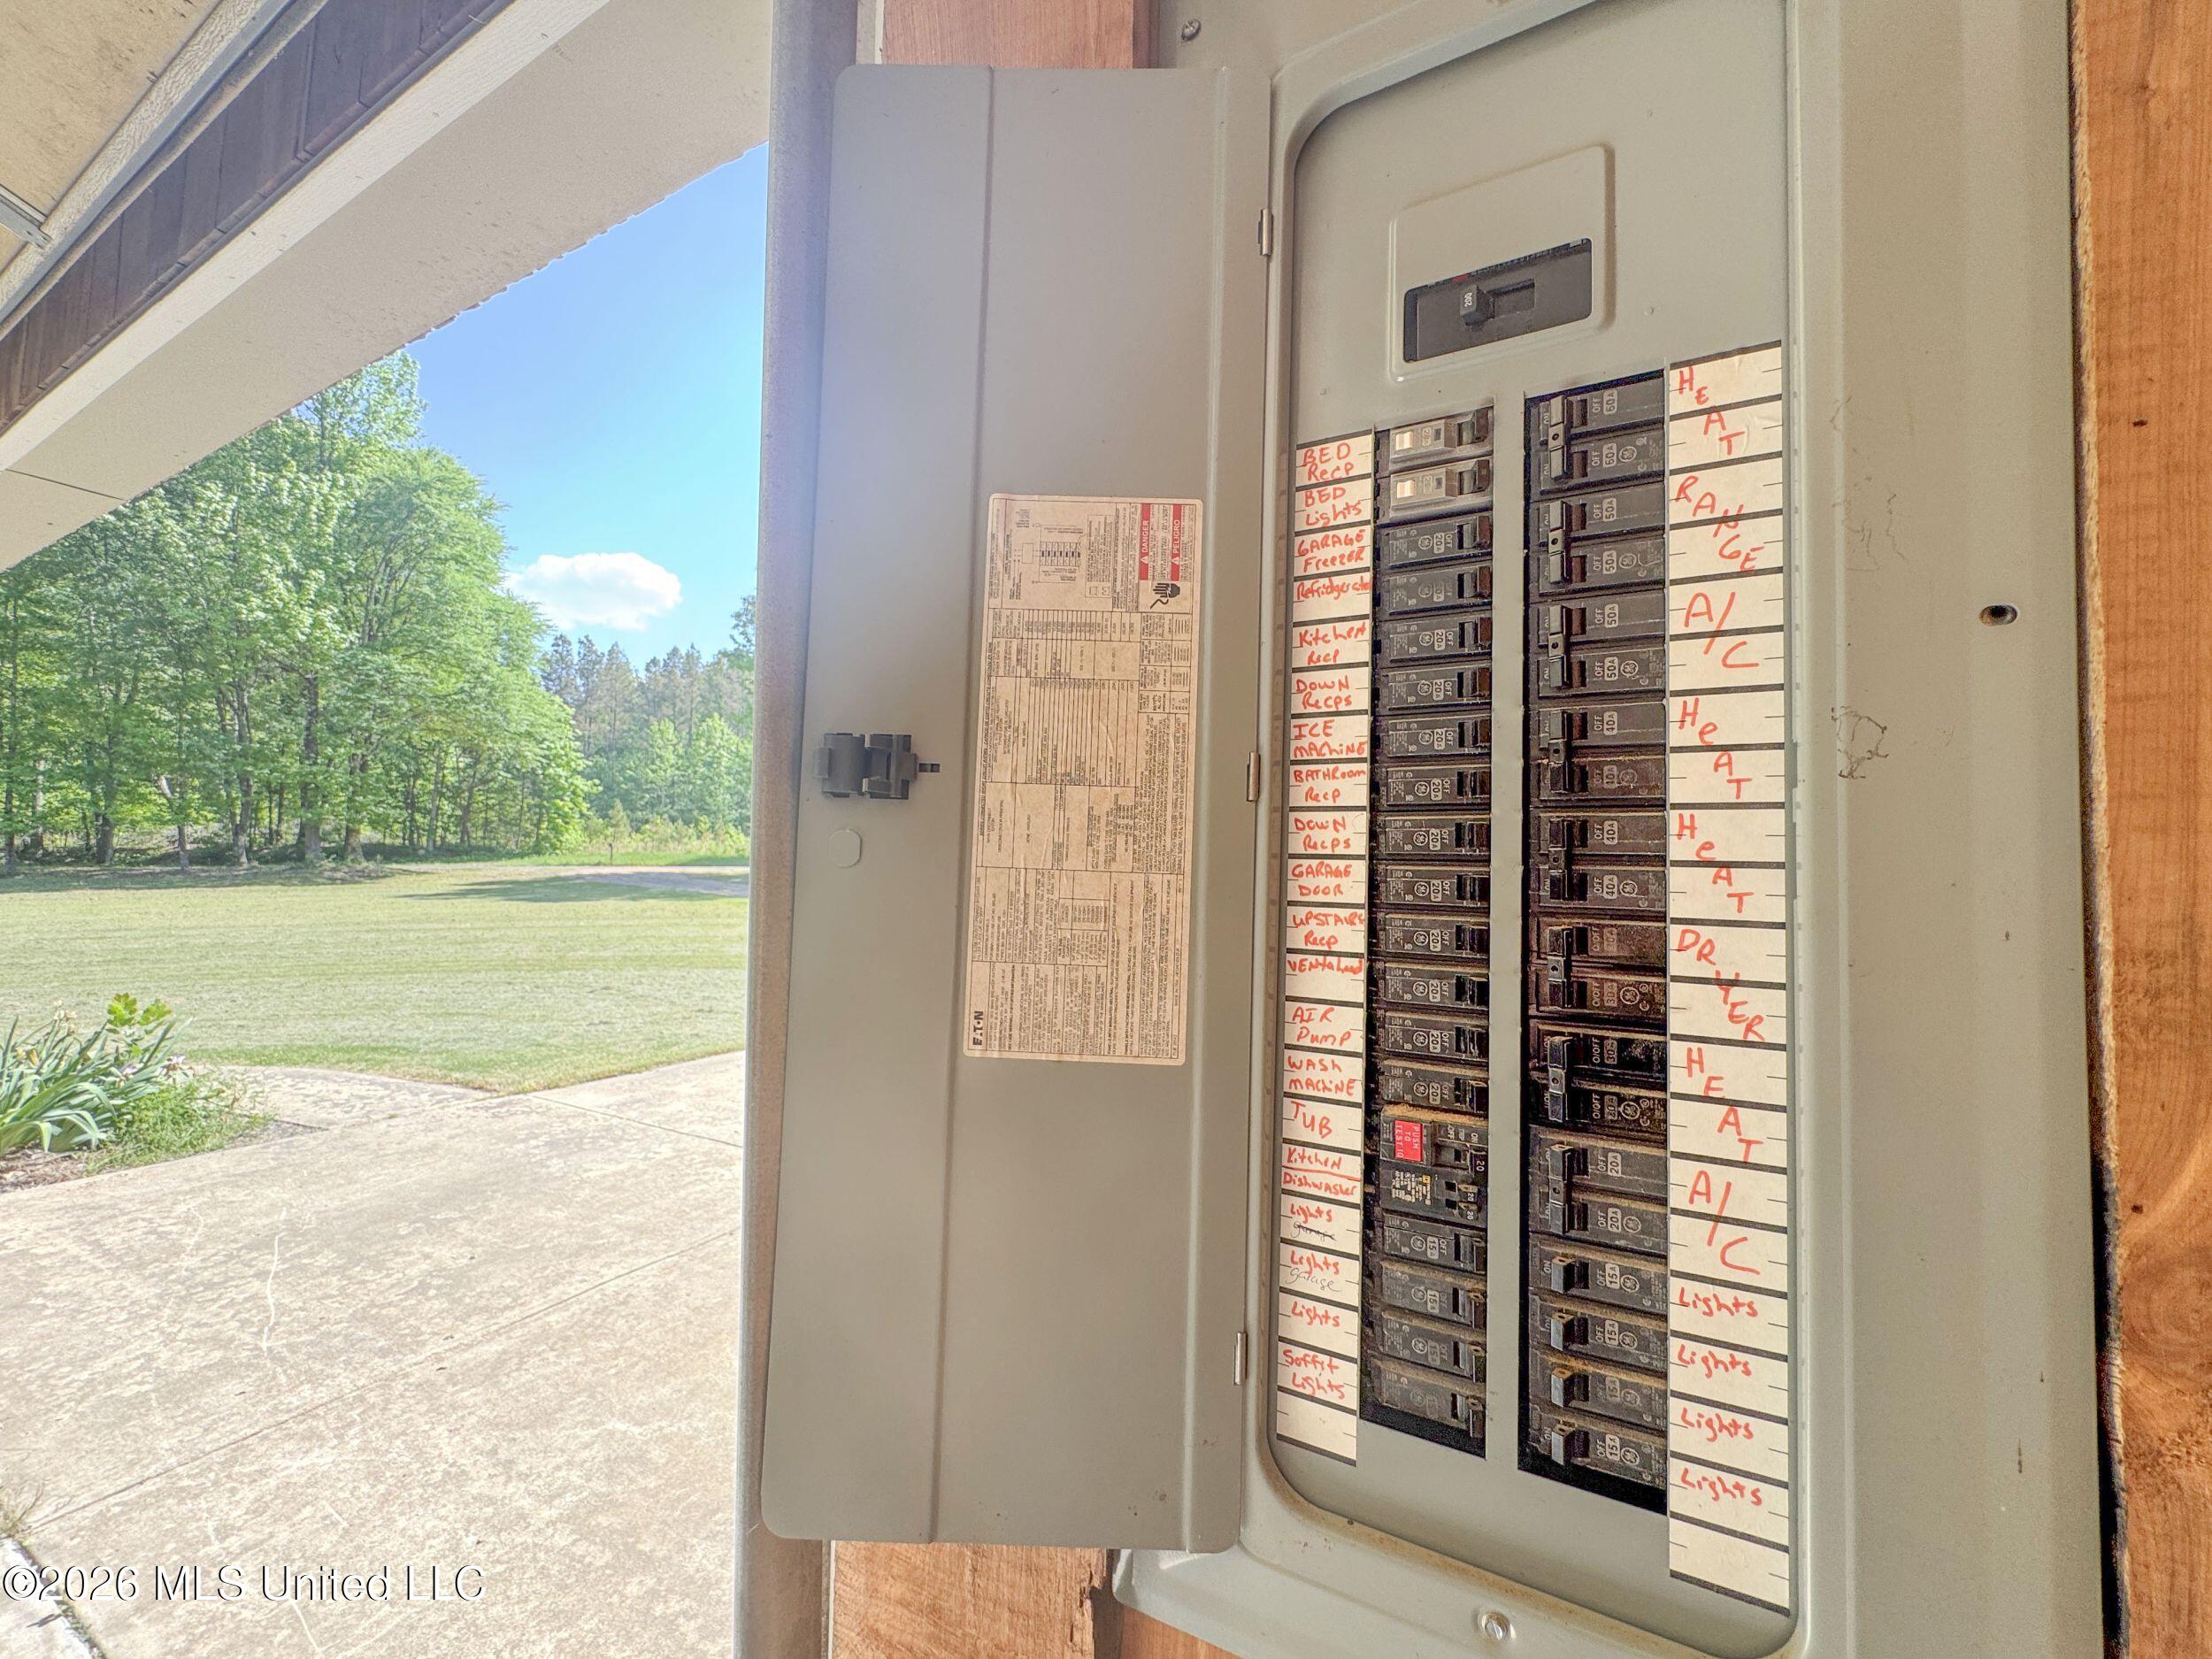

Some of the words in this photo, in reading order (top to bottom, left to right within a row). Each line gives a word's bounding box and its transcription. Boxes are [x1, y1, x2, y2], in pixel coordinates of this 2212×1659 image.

[1678, 365, 1746, 456] HEAT
[1303, 442, 1351, 465] BED
[1592, 450, 1601, 465] OFF
[1304, 487, 1346, 507] BED
[1306, 500, 1362, 526] Lights
[1605, 500, 1615, 518] 50A
[1675, 475, 1765, 572] RANGE
[1172, 519, 1181, 554] PELIGRO
[1298, 529, 1365, 556] GARAGE
[1605, 553, 1615, 572] 50A
[1607, 606, 1616, 626] 50A
[1684, 591, 1760, 667] A/C
[1435, 632, 1444, 648] 20A
[1607, 659, 1616, 679] 50A
[1294, 719, 1335, 739] ICE
[1435, 731, 1444, 748] 20A
[1292, 861, 1352, 879] GARAGE
[1298, 883, 1343, 896] DOOR
[1431, 932, 1440, 949] 20A
[1430, 982, 1439, 1000] 20A
[1677, 929, 1766, 1041] DRYER
[1293, 1006, 1334, 1023] AIR
[1686, 1047, 1764, 1163] HEAT
[1291, 1101, 1333, 1139] TUB
[1405, 1132, 1410, 1142] TO
[1471, 1133, 1478, 1142] ON
[1477, 1161, 1484, 1171] 20
[1598, 1155, 1607, 1171] OFF
[1609, 1155, 1619, 1174] 20A
[1598, 1211, 1607, 1226] OFF
[1609, 1210, 1619, 1230] 20A
[1688, 1170, 1761, 1275] A/C
[1608, 1265, 1618, 1286] 15A
[1678, 1286, 1758, 1317] Lights
[1292, 1301, 1340, 1327] Lights
[1608, 1323, 1617, 1342] 15A
[1677, 1344, 1753, 1379] Lights
[1292, 1372, 1345, 1400] Lights
[1680, 1407, 1754, 1443] Lights
[1680, 1468, 1762, 1506] Lights
